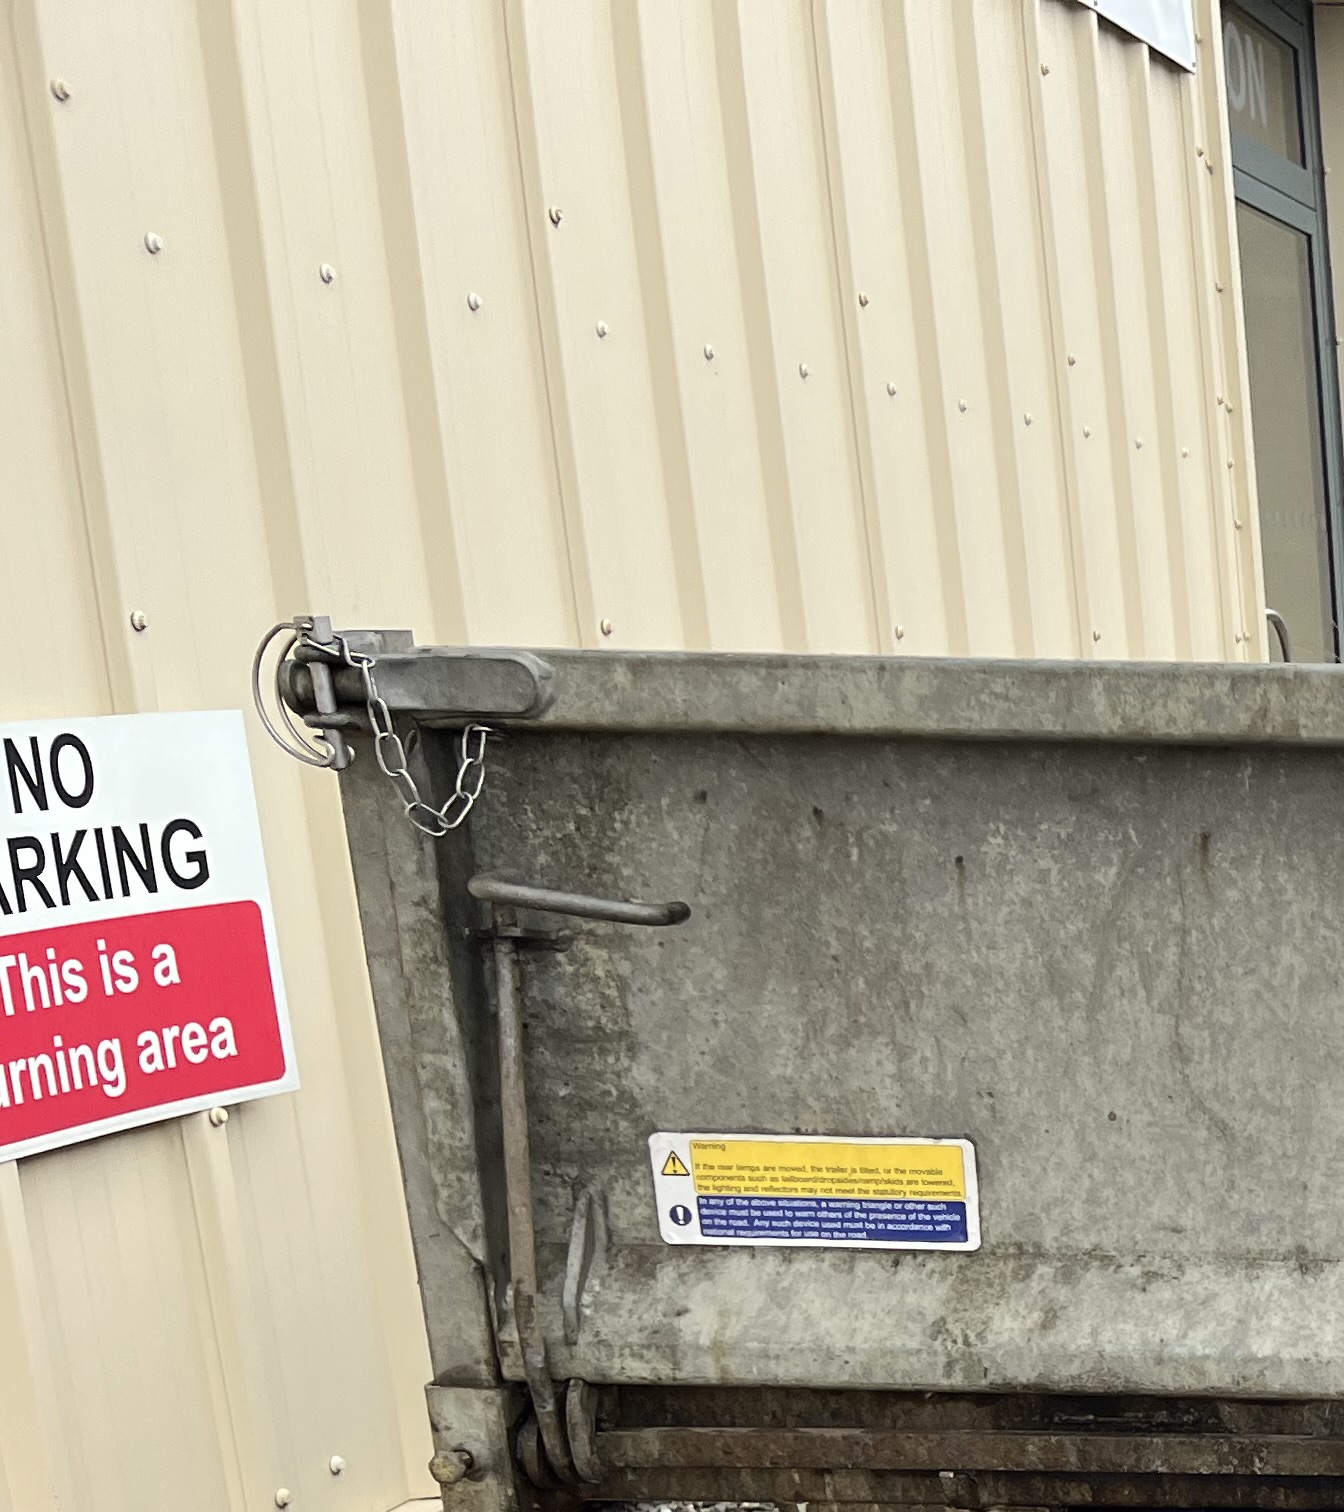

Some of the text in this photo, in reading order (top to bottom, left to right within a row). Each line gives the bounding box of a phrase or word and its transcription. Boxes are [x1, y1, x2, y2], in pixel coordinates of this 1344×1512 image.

[3, 733, 94, 814] NO
[0, 818, 210, 915] RKING
[0, 938, 180, 1016] This is a
[137, 1015, 238, 1074] area
[692, 1142, 726, 1152] Warning
[696, 1174, 745, 1182] components
[712, 1184, 741, 1193] lighting
[800, 1187, 817, 1195] may
[735, 1198, 749, 1206] the
[862, 1201, 892, 1210] triangle
[933, 1213, 960, 1221] vehicle
[754, 1219, 770, 1228] Any
